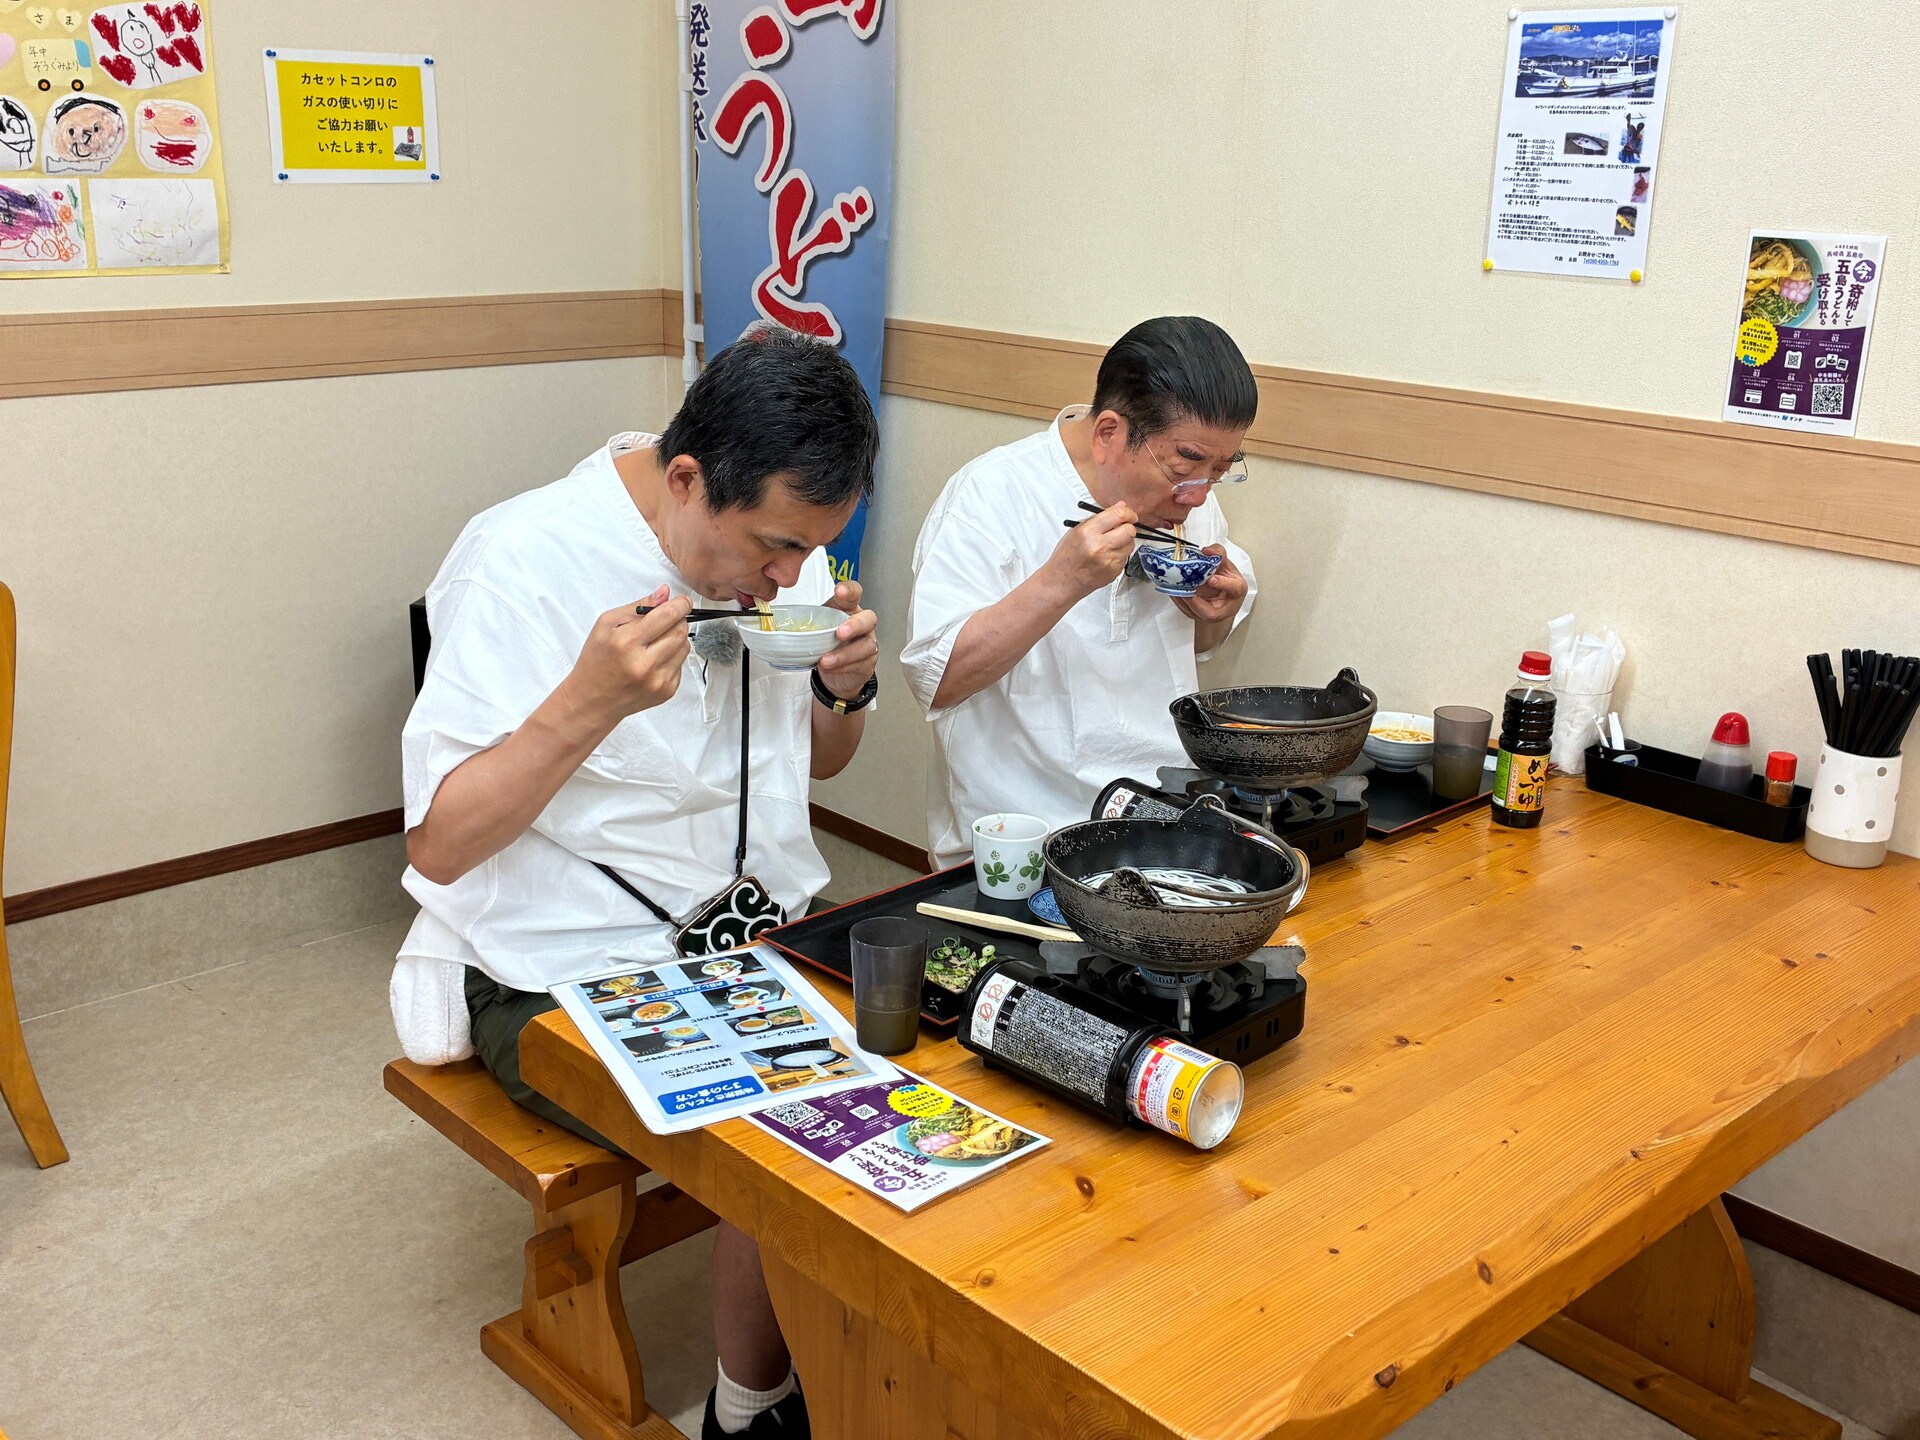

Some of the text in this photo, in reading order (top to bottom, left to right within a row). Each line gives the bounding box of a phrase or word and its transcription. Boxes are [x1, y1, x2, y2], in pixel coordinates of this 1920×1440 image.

[28, 46, 47, 57] 年中
[301, 72, 397, 88] カセットコンロの
[303, 95, 398, 110] ガスの使い切りに
[317, 117, 388, 132] ご協力お願い
[318, 140, 383, 154] いたします。
[1816, 273, 1831, 326] 受け取れる
[1831, 259, 1851, 325] 五島うどんを
[1845, 284, 1865, 326] 寄附して
[1518, 759, 1544, 809] めんつゆ
[675, 1081, 742, 1103] 3つの食べ方
